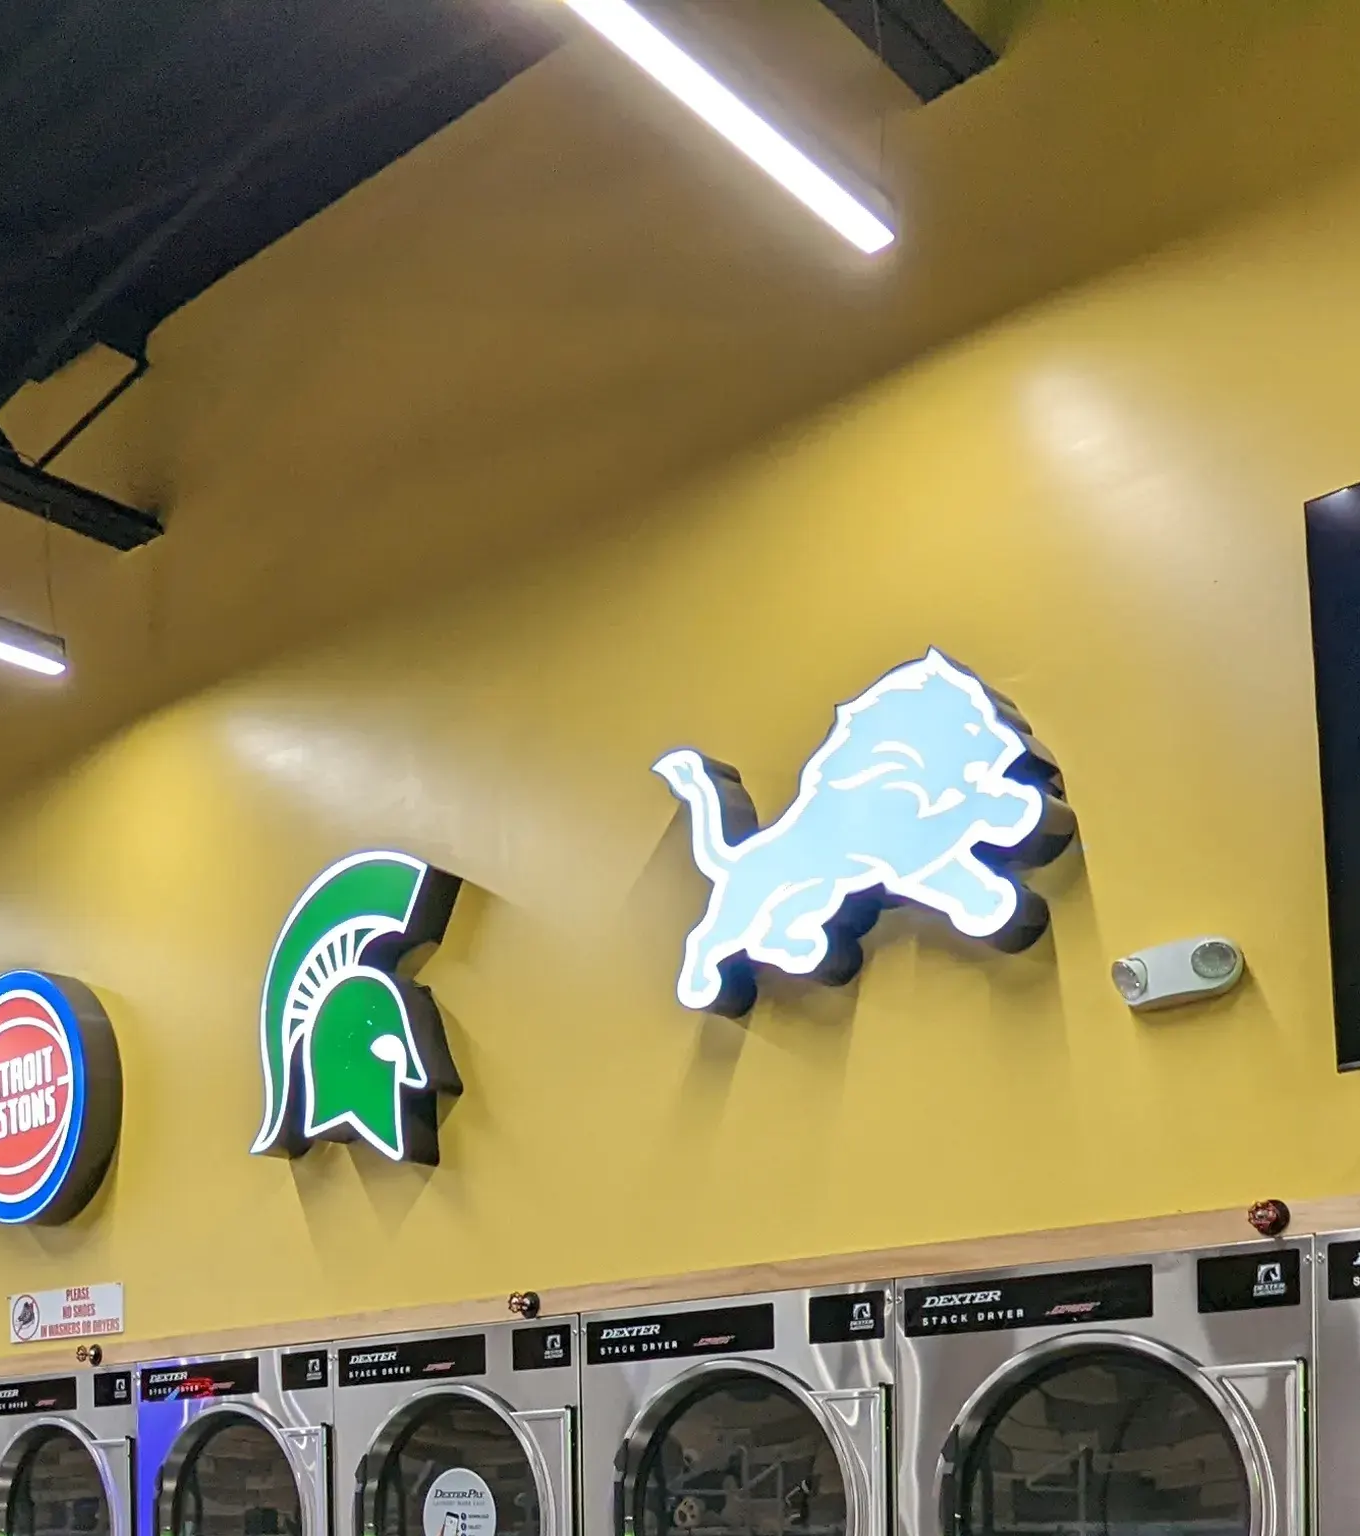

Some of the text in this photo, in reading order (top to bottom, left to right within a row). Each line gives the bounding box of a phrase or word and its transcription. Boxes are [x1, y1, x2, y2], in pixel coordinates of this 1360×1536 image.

[66, 1287, 90, 1302] PLEASE
[922, 1290, 1003, 1309] DEXTER
[62, 1304, 96, 1320] NO SHOES
[922, 1308, 1024, 1327] STACK DRYER
[49, 1321, 81, 1337] WASHERS
[82, 1320, 92, 1333] OR
[93, 1318, 120, 1333] DRYERS
[600, 1324, 661, 1340] DEXTER
[600, 1341, 678, 1356] STACK DRYER
[349, 1351, 397, 1365] DEXTER
[149, 1371, 188, 1384] DEXTER
